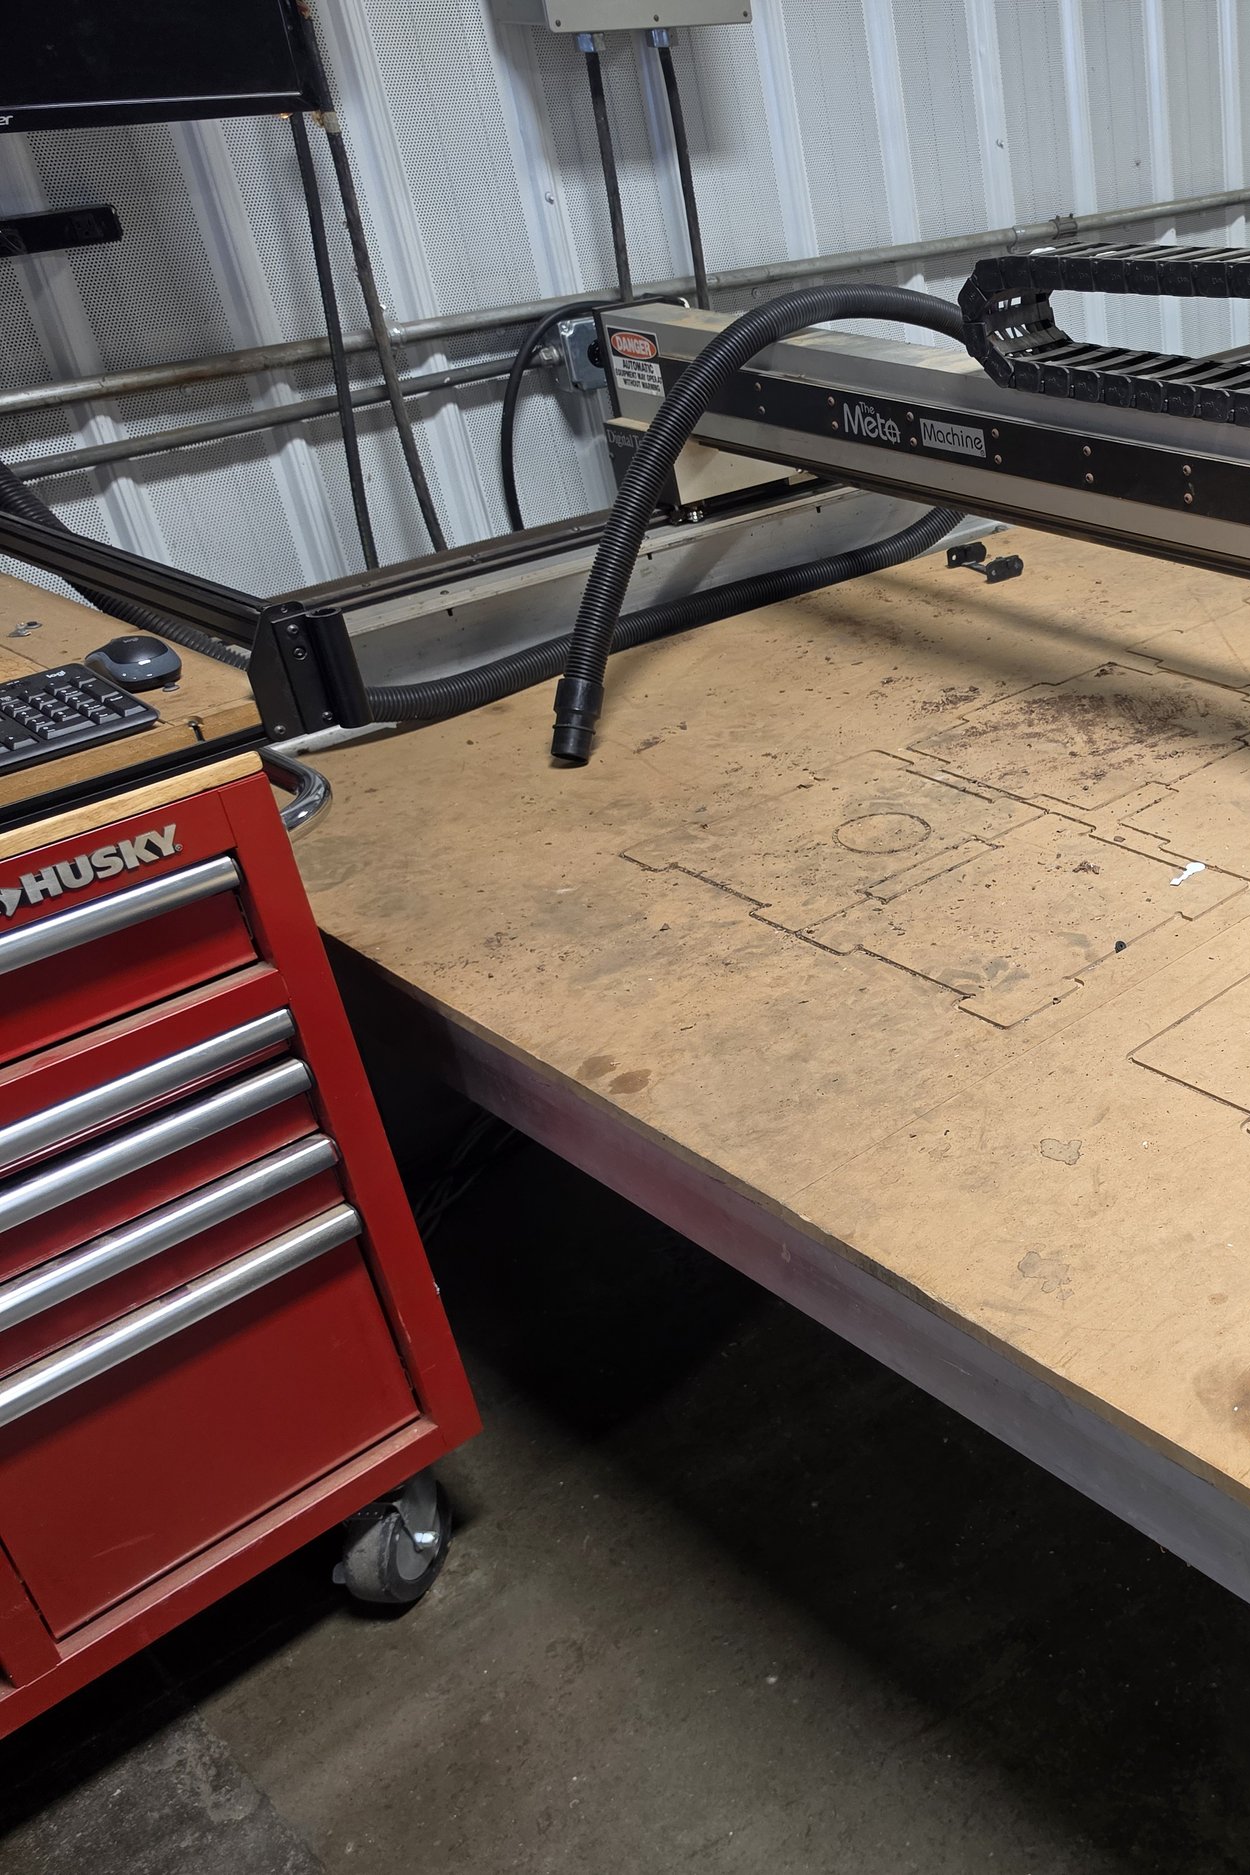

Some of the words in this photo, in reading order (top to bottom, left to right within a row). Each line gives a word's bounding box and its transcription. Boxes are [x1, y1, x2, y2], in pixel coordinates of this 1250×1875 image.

[615, 335, 652, 357] DANGER
[622, 359, 654, 374] AUTOMATIC
[858, 401, 875, 415] The
[843, 402, 901, 445] Meta
[922, 422, 983, 451] Machine
[606, 429, 634, 448] Digital
[45, 670, 66, 679] logi
[19, 823, 177, 905] HUSKY
